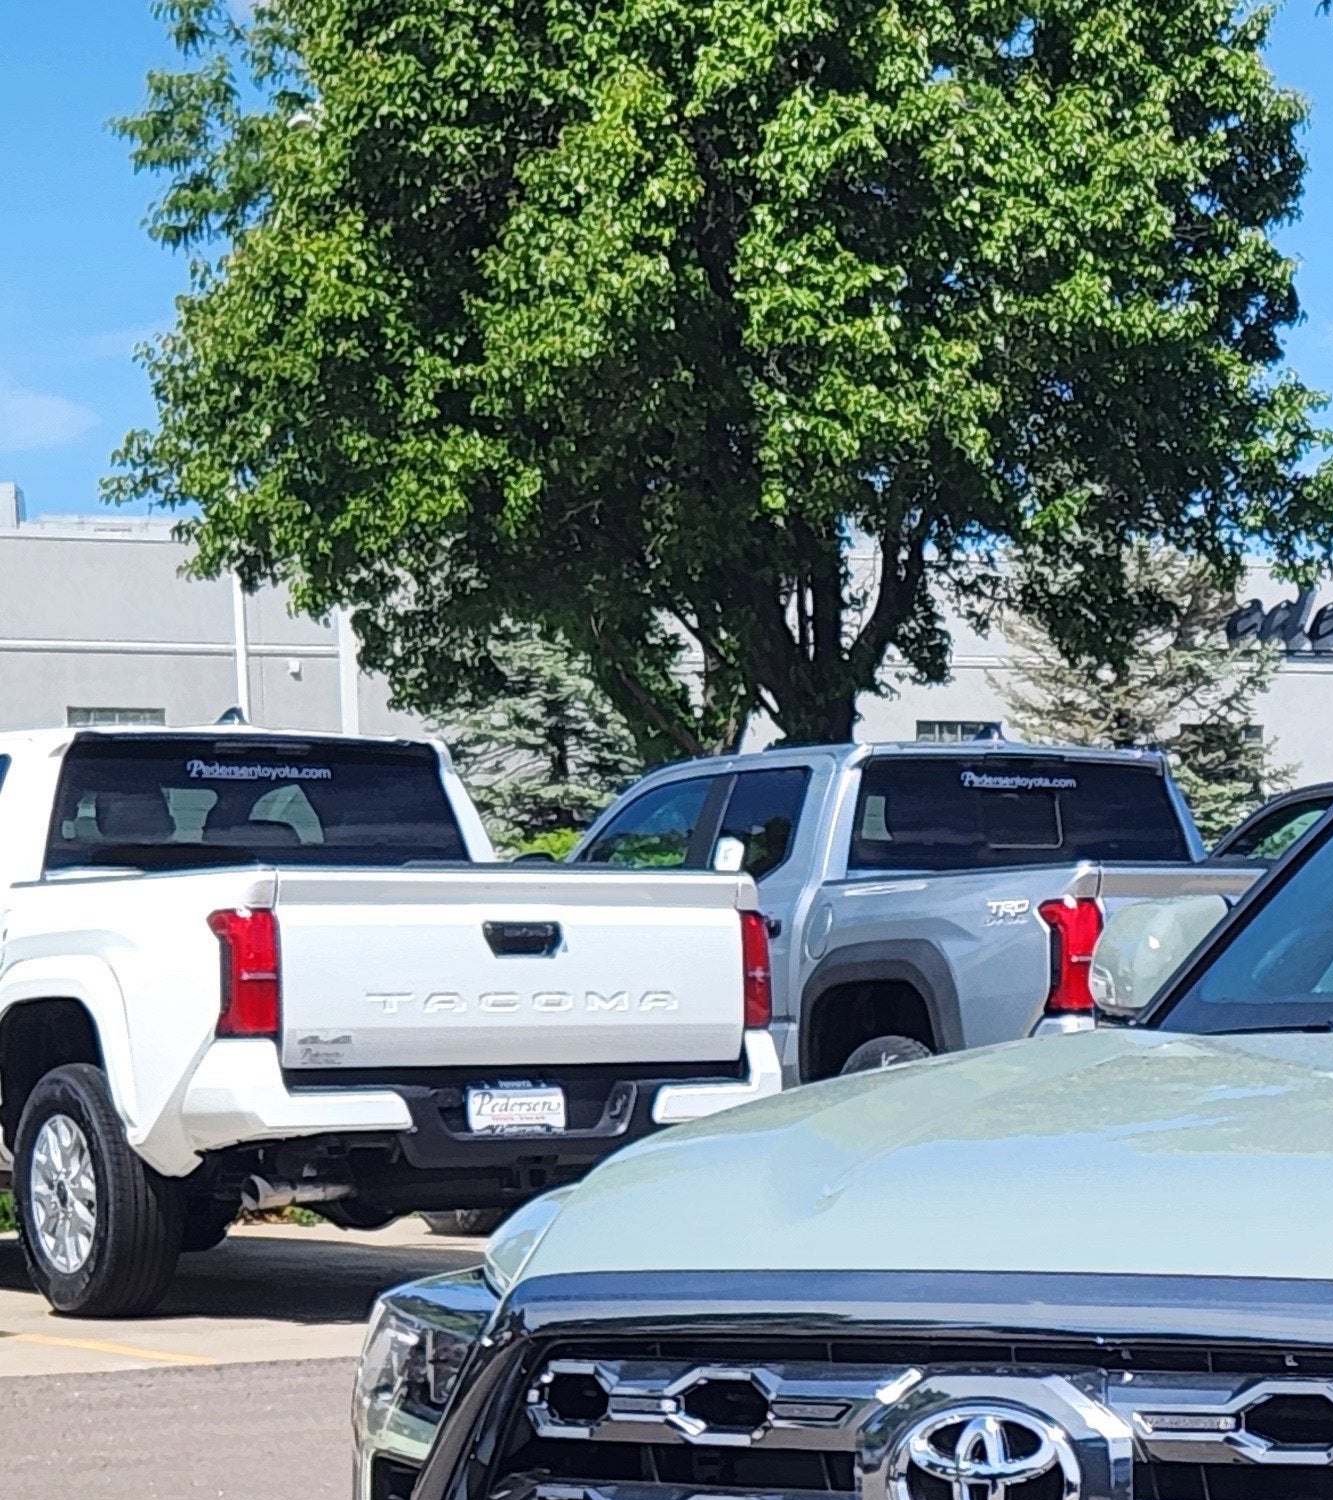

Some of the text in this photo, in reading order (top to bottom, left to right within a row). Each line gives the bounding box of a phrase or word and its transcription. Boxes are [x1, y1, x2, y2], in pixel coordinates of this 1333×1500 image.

[986, 899, 1030, 918] TRD
[365, 990, 680, 1014] TACOMA
[472, 1091, 562, 1116] Pedersen
